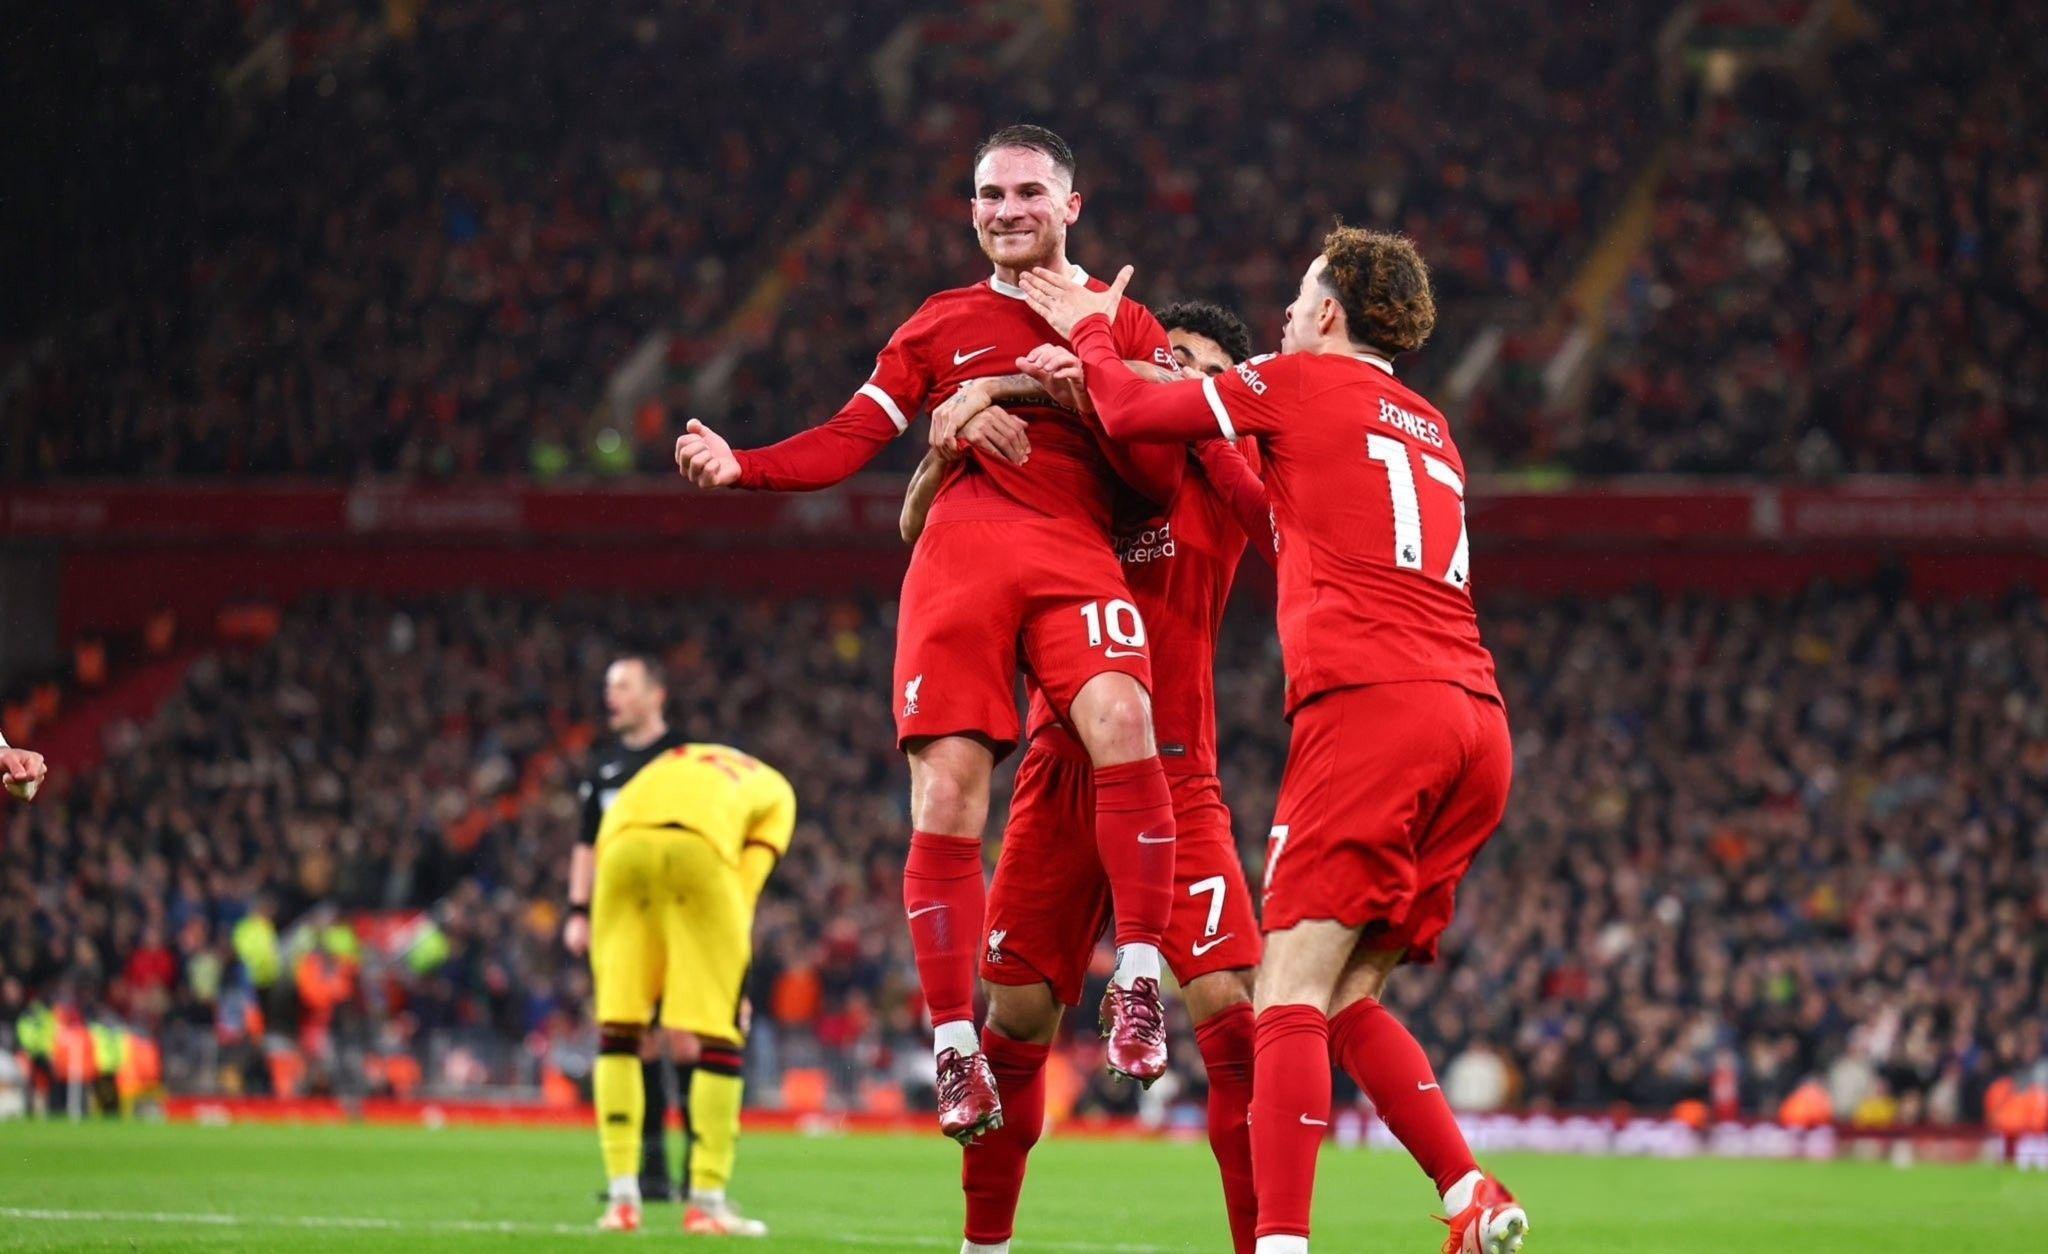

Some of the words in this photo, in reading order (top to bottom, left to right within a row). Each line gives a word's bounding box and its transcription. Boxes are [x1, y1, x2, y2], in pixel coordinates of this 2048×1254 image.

[1234, 361, 1268, 395] edia
[1379, 397, 1443, 448] JONES
[1366, 432, 1470, 592] 17
[1080, 598, 1146, 648] 10
[1188, 875, 1226, 937] 7
[986, 953, 1004, 965] LFC
